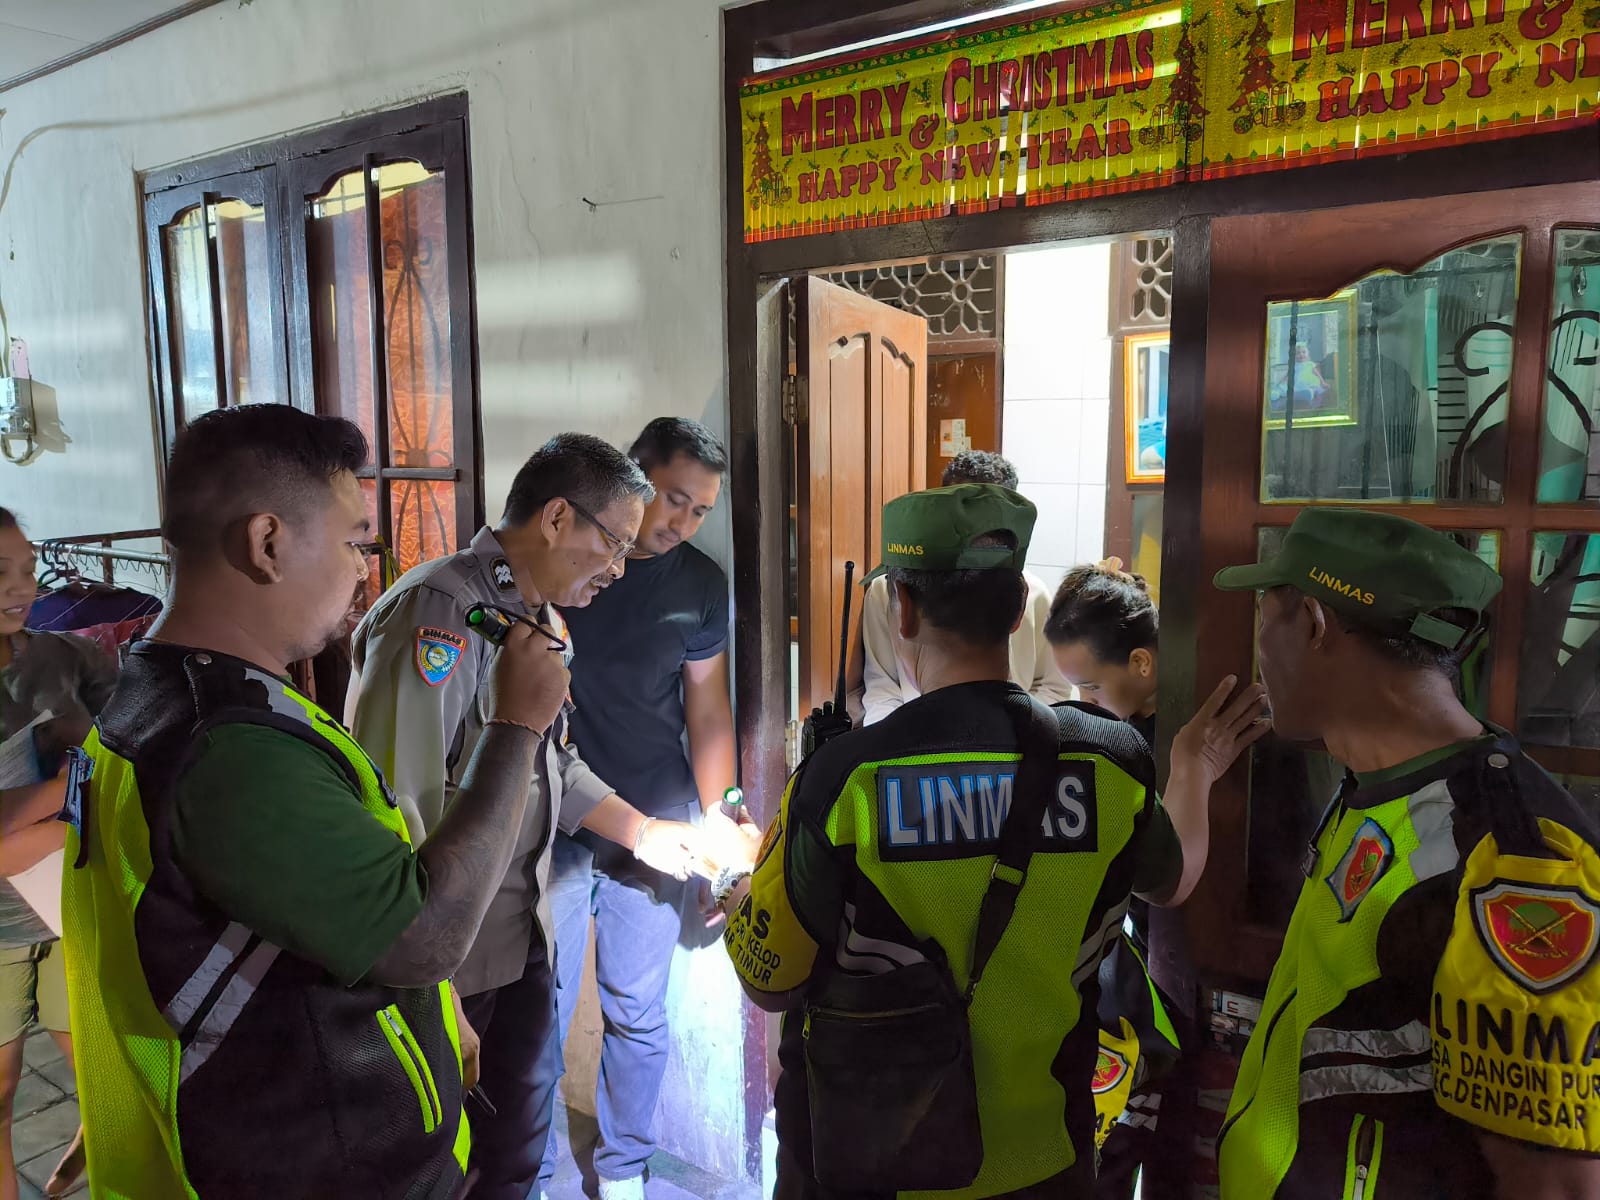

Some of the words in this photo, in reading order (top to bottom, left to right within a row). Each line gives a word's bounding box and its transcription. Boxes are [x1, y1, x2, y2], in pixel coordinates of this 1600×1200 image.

[781, 82, 911, 156] MERRY
[942, 29, 1155, 125] CHRISTMAS
[1316, 51, 1502, 122] HAPPY
[909, 114, 940, 150] &
[797, 156, 902, 204] HAPPY
[920, 137, 1000, 186] NEW
[1015, 119, 1133, 169] YEAR
[887, 542, 925, 556] LINMAS
[1309, 566, 1375, 606] LINMAS
[738, 892, 771, 940] AS
[736, 943, 772, 985] TIMUR
[746, 934, 781, 970] KELOD
[1460, 1051, 1548, 1095] DANGIN
